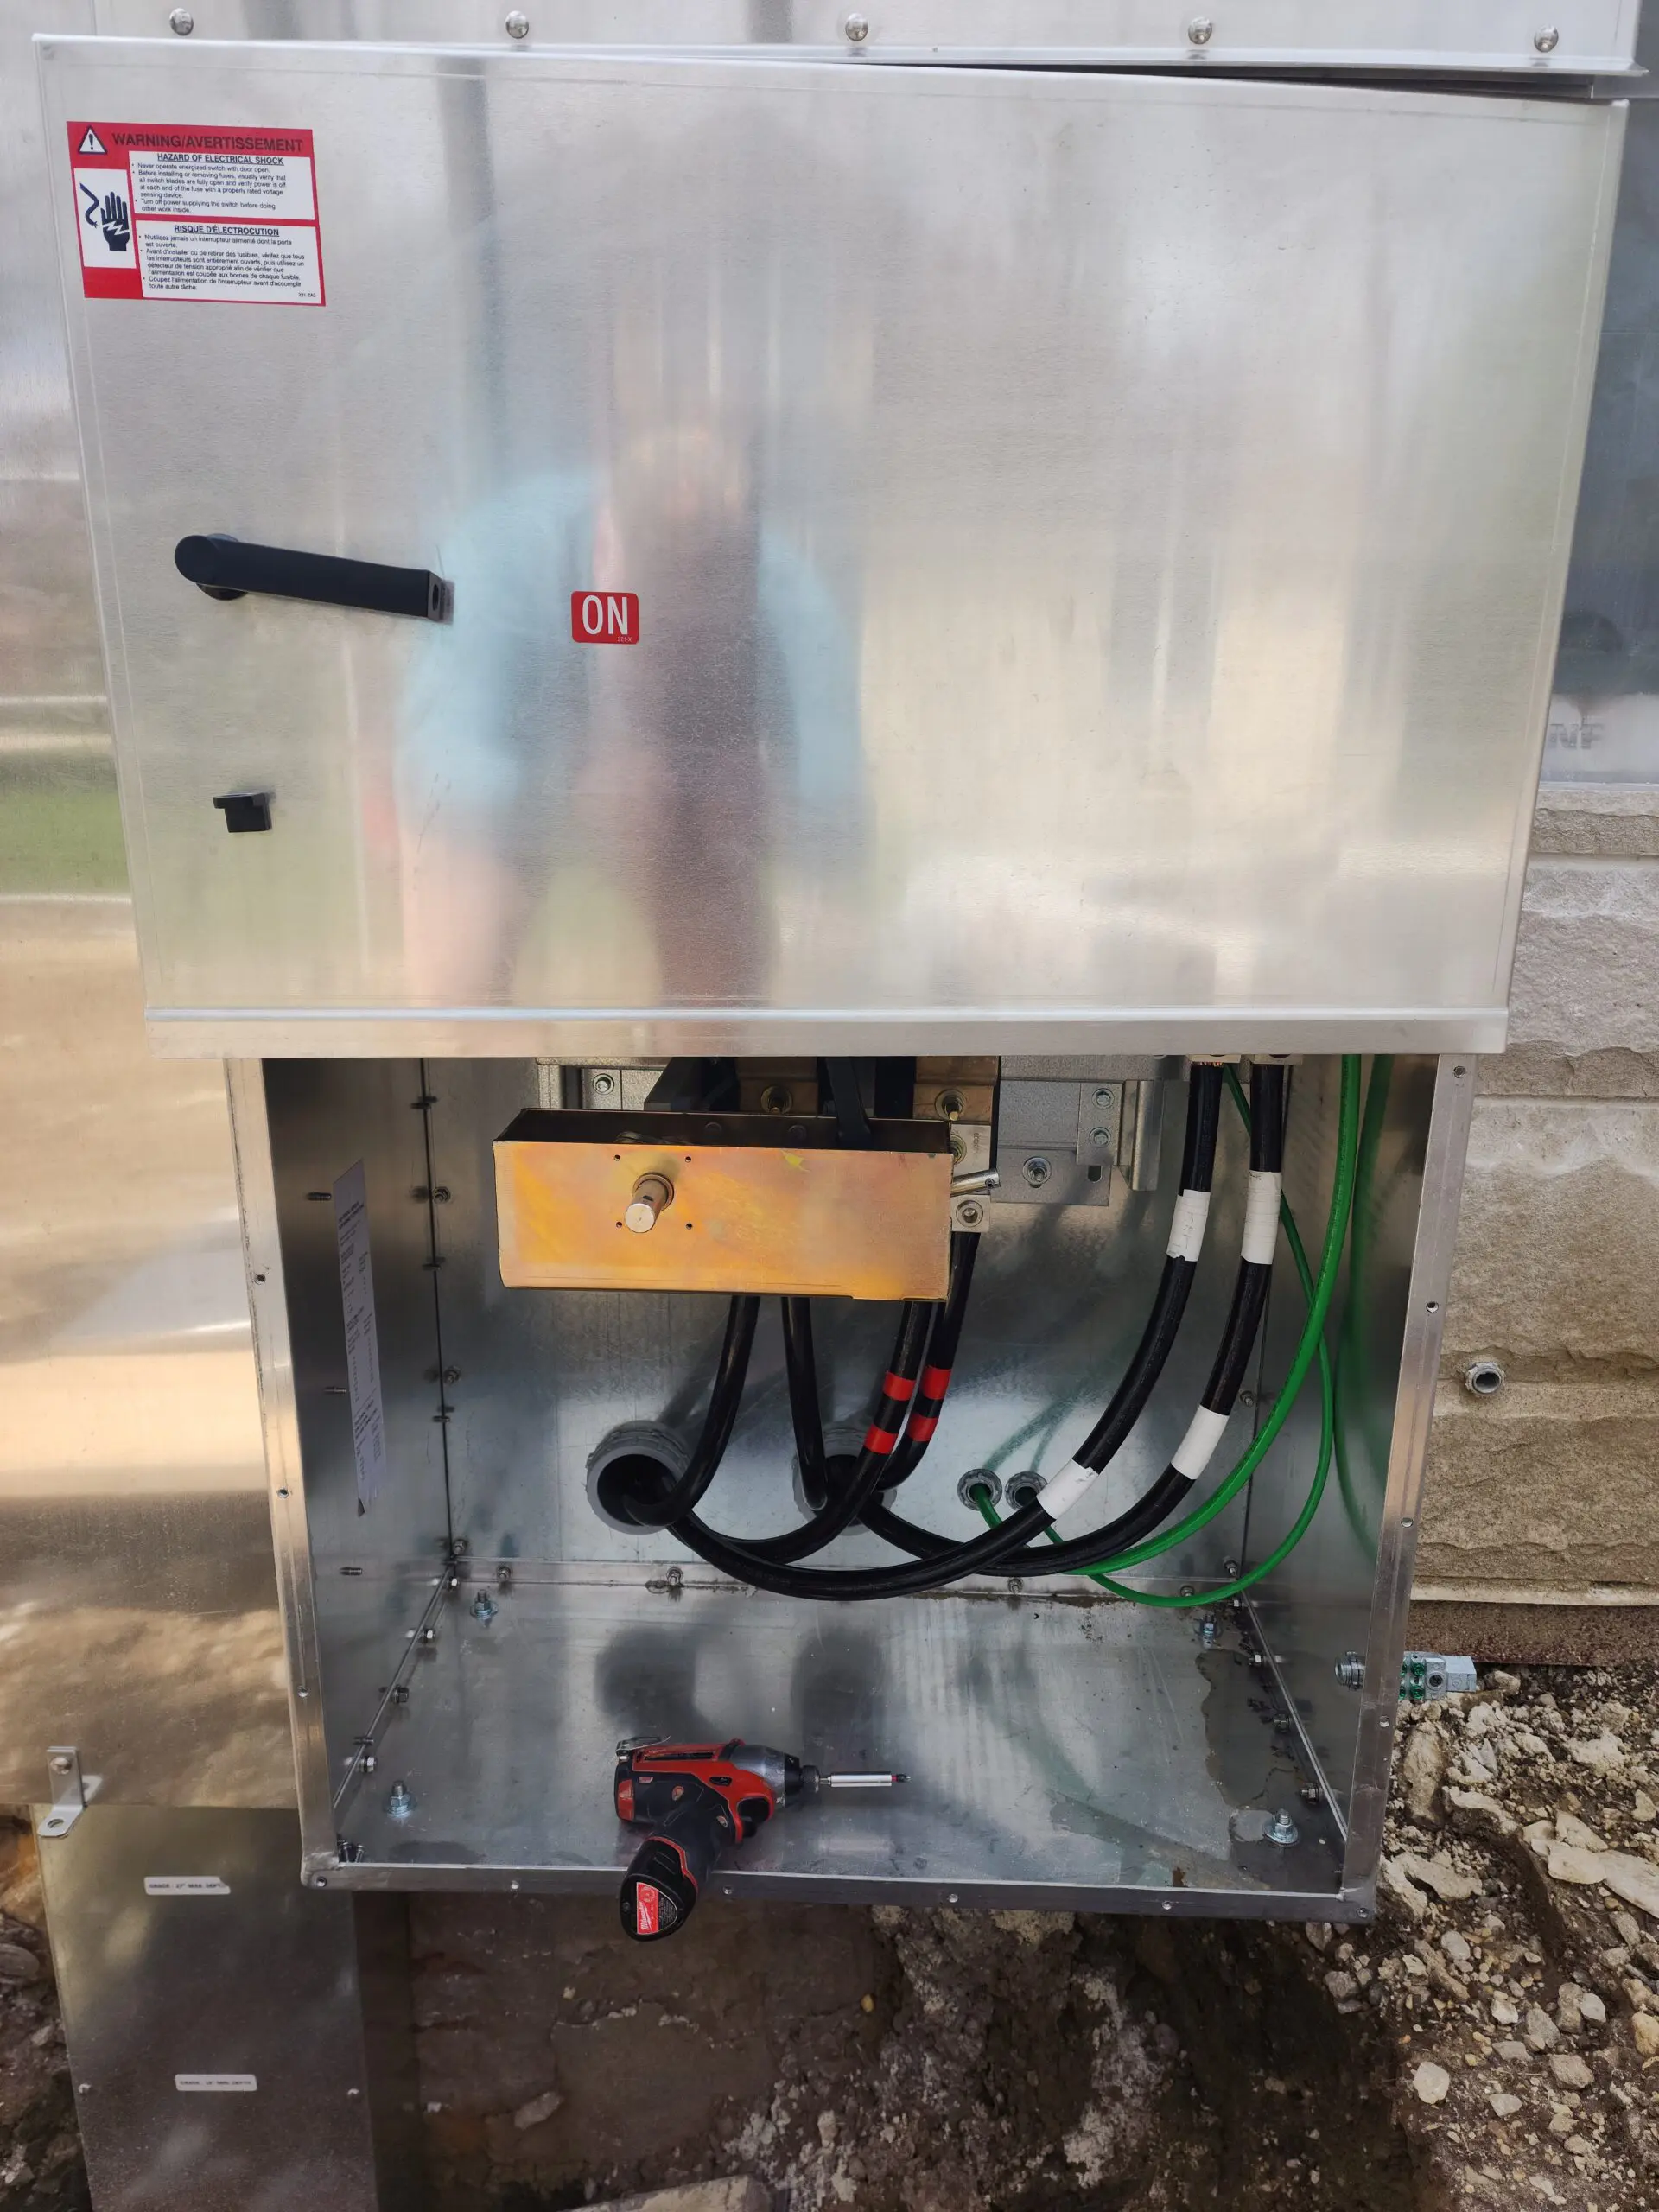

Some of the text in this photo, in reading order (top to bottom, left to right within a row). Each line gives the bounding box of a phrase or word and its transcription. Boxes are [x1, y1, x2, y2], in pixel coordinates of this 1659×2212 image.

[111, 133, 303, 152] WARNING/AVERTISSEMENT
[205, 155, 252, 164] ELECTRICAL
[207, 225, 279, 235] D'ÉLECTROCUTION
[582, 594, 627, 635] ON
